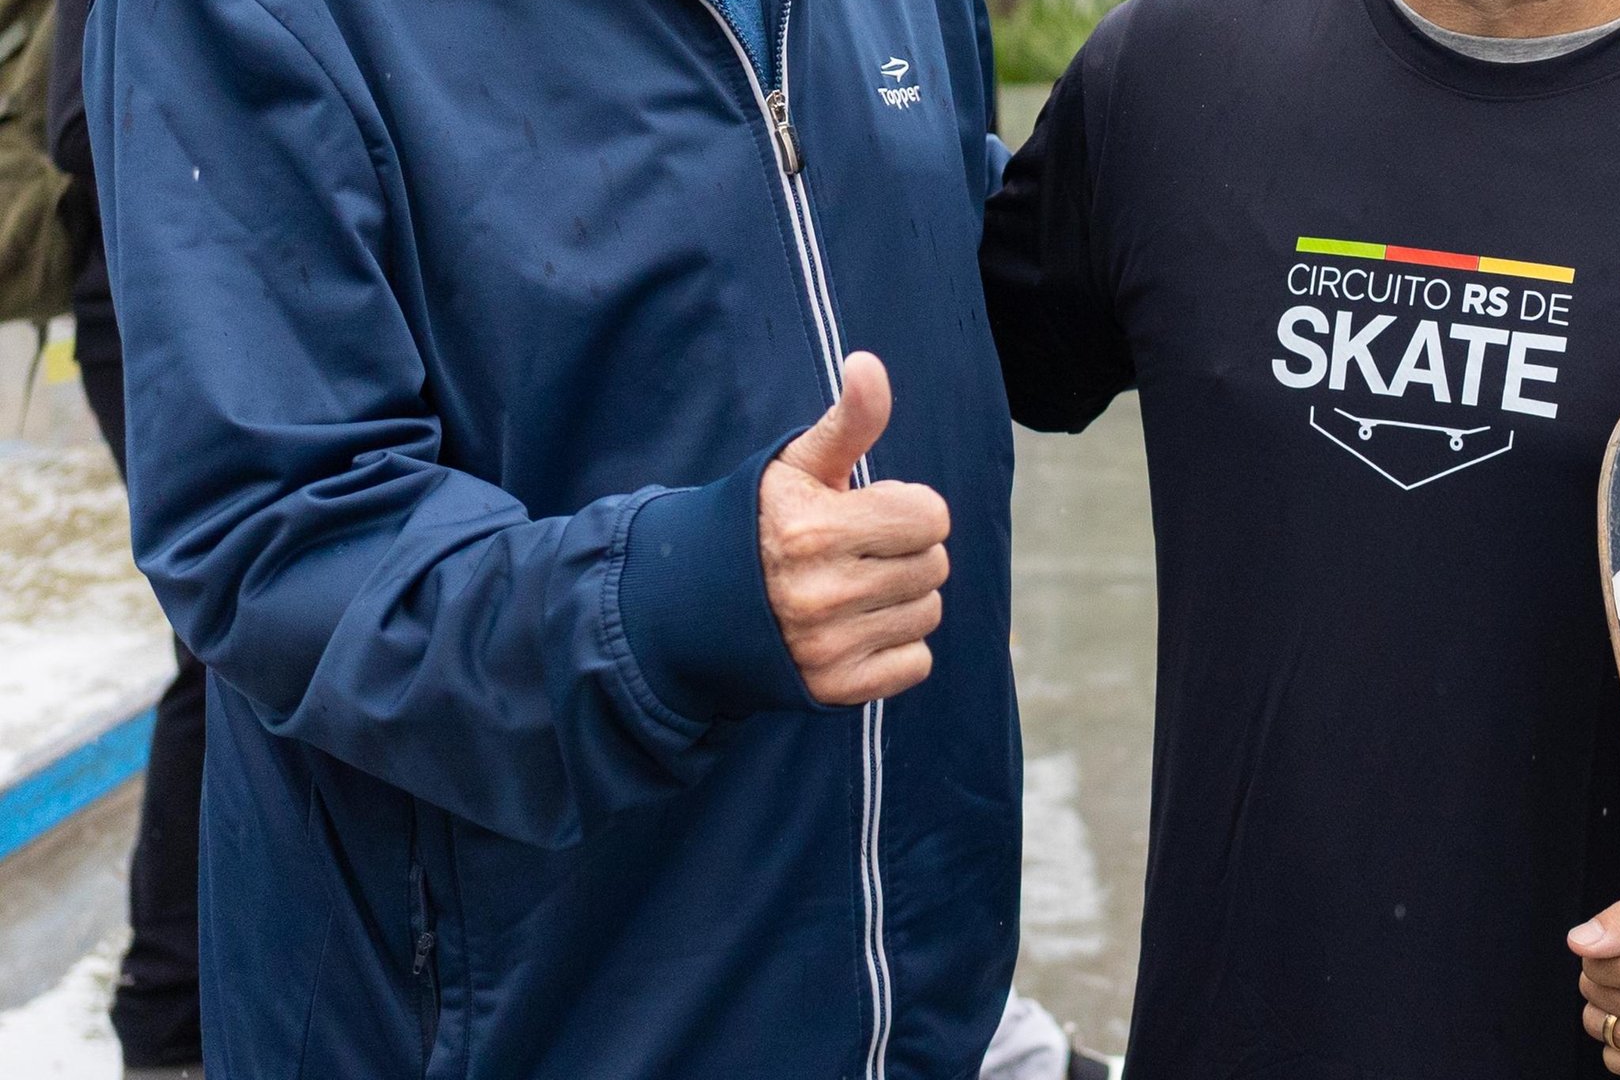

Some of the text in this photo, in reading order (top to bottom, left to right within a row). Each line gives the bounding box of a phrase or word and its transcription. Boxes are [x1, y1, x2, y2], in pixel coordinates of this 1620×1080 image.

[877, 85, 921, 110] Topper
[1287, 263, 1573, 326] CIRCUITO RS DE
[1271, 305, 1568, 419] SKATE
